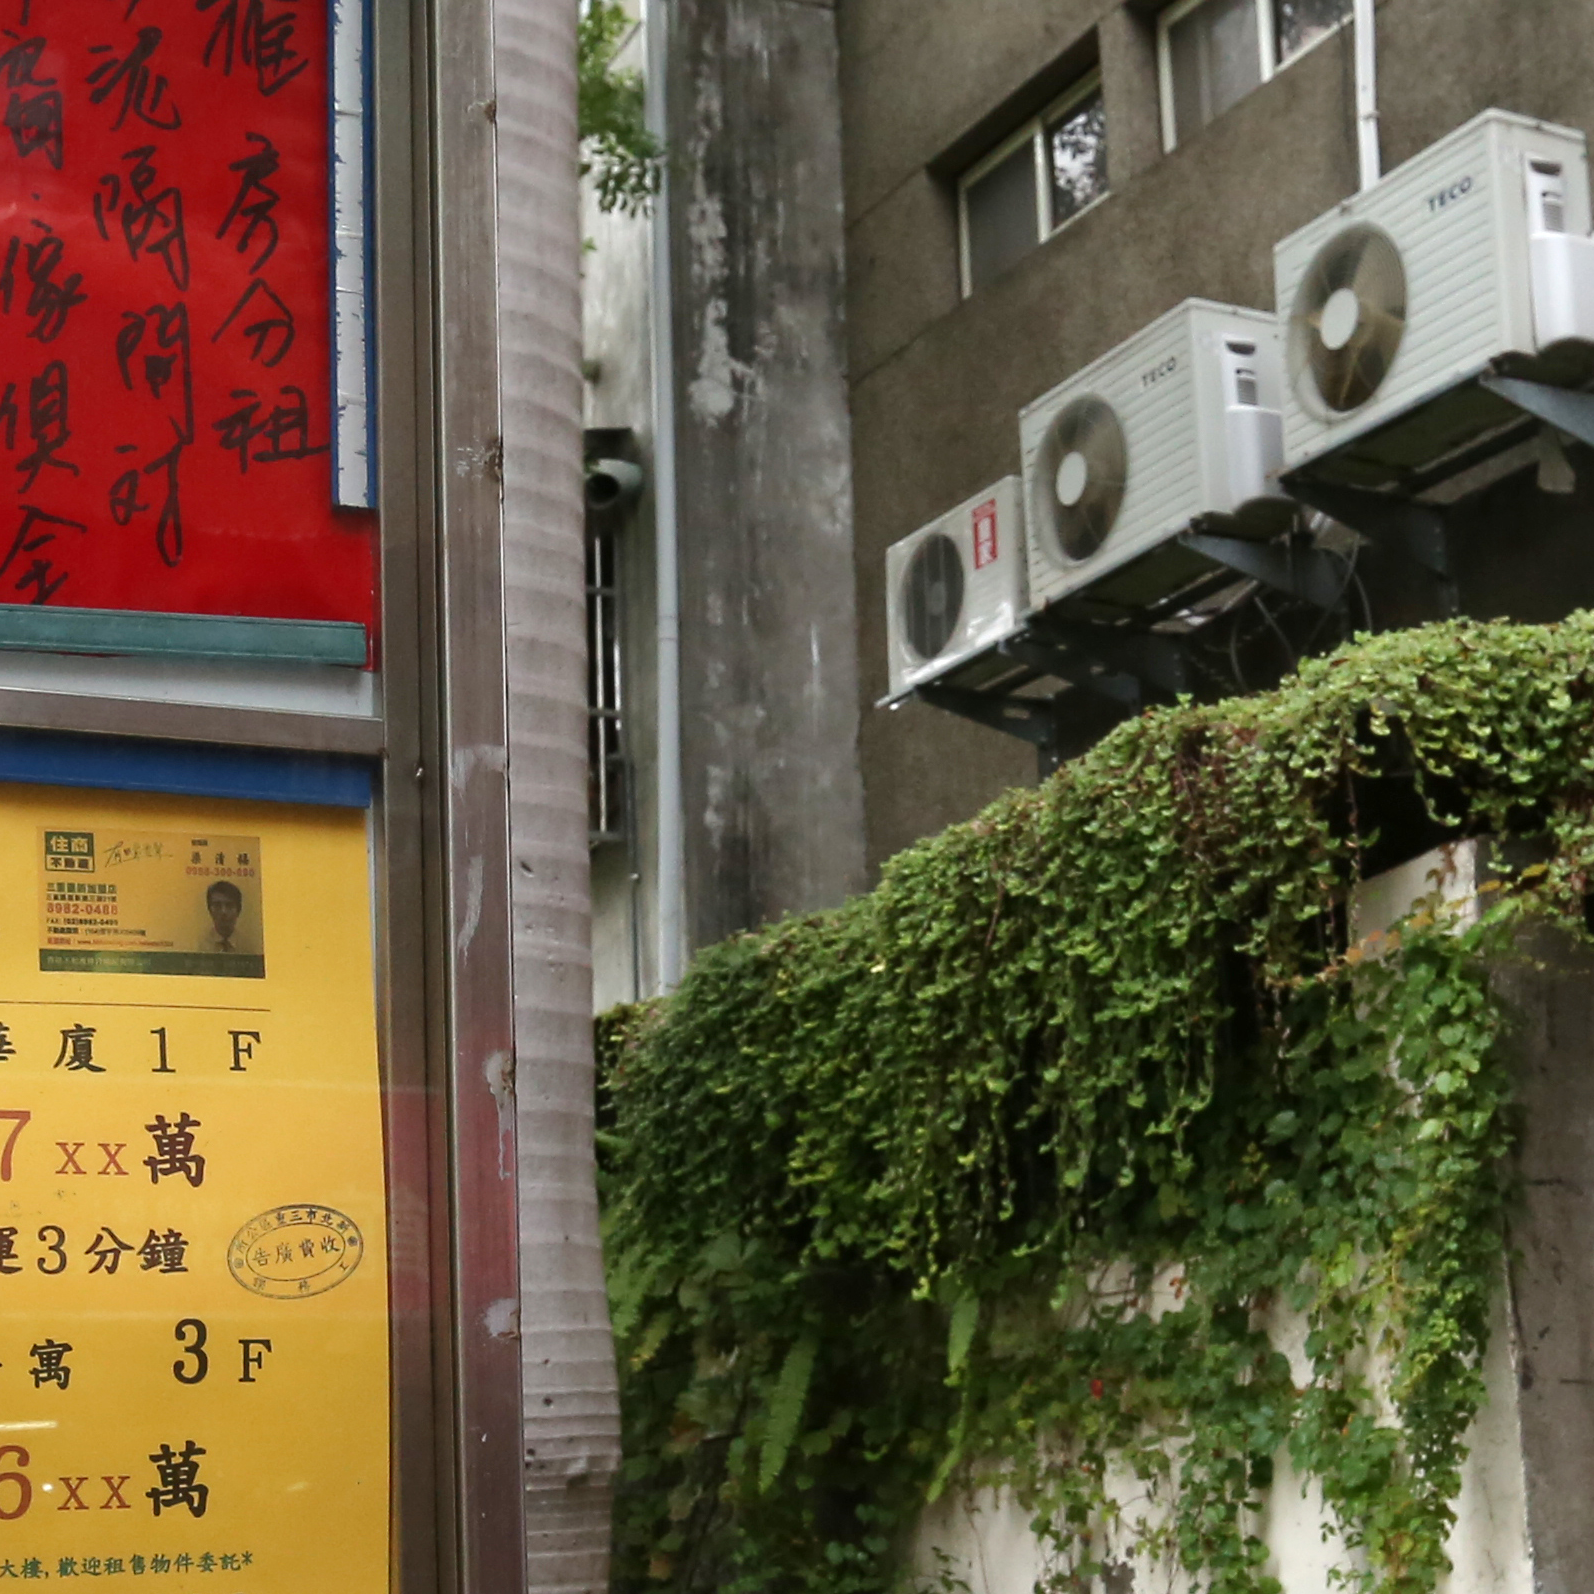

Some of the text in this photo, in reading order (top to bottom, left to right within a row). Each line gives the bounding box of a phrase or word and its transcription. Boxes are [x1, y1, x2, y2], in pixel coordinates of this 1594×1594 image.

[1427, 176, 1474, 212] TECO
[1140, 356, 1178, 388] TECO
[50, 835, 89, 854] 住商
